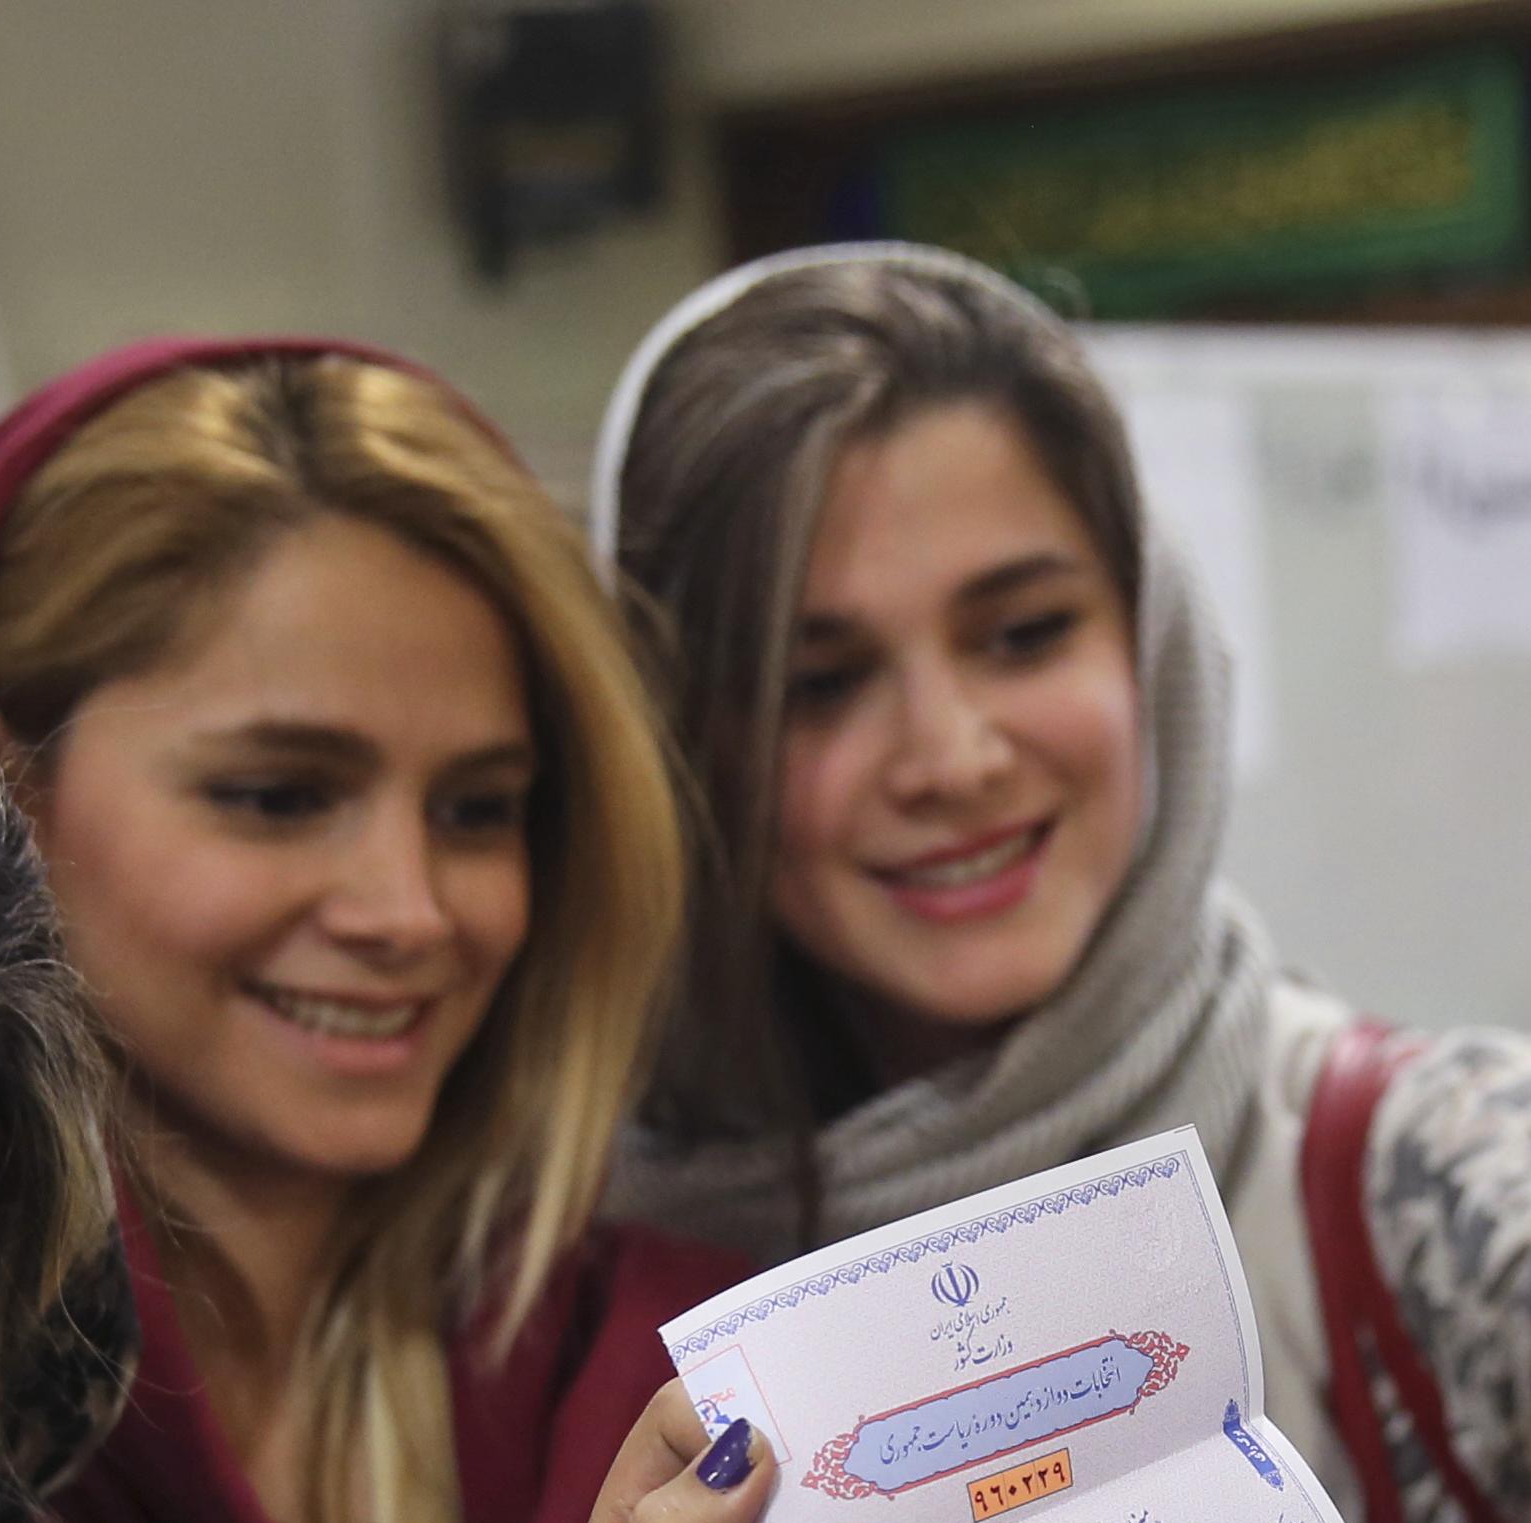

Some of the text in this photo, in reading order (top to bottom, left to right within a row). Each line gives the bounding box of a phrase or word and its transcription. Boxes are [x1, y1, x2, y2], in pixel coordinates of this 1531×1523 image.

[929, 1295, 1012, 1342] جمهوری اسلامی ایران
[953, 1320, 1014, 1373] وزارت کشور
[1068, 1354, 1122, 1401] انتخابات
[1003, 1385, 1070, 1432] دوازدهمین
[879, 1424, 923, 1466] جمهوری
[920, 1420, 973, 1452] ریاست
[973, 1460, 1067, 1513] ۹۶۰۲۲۹
